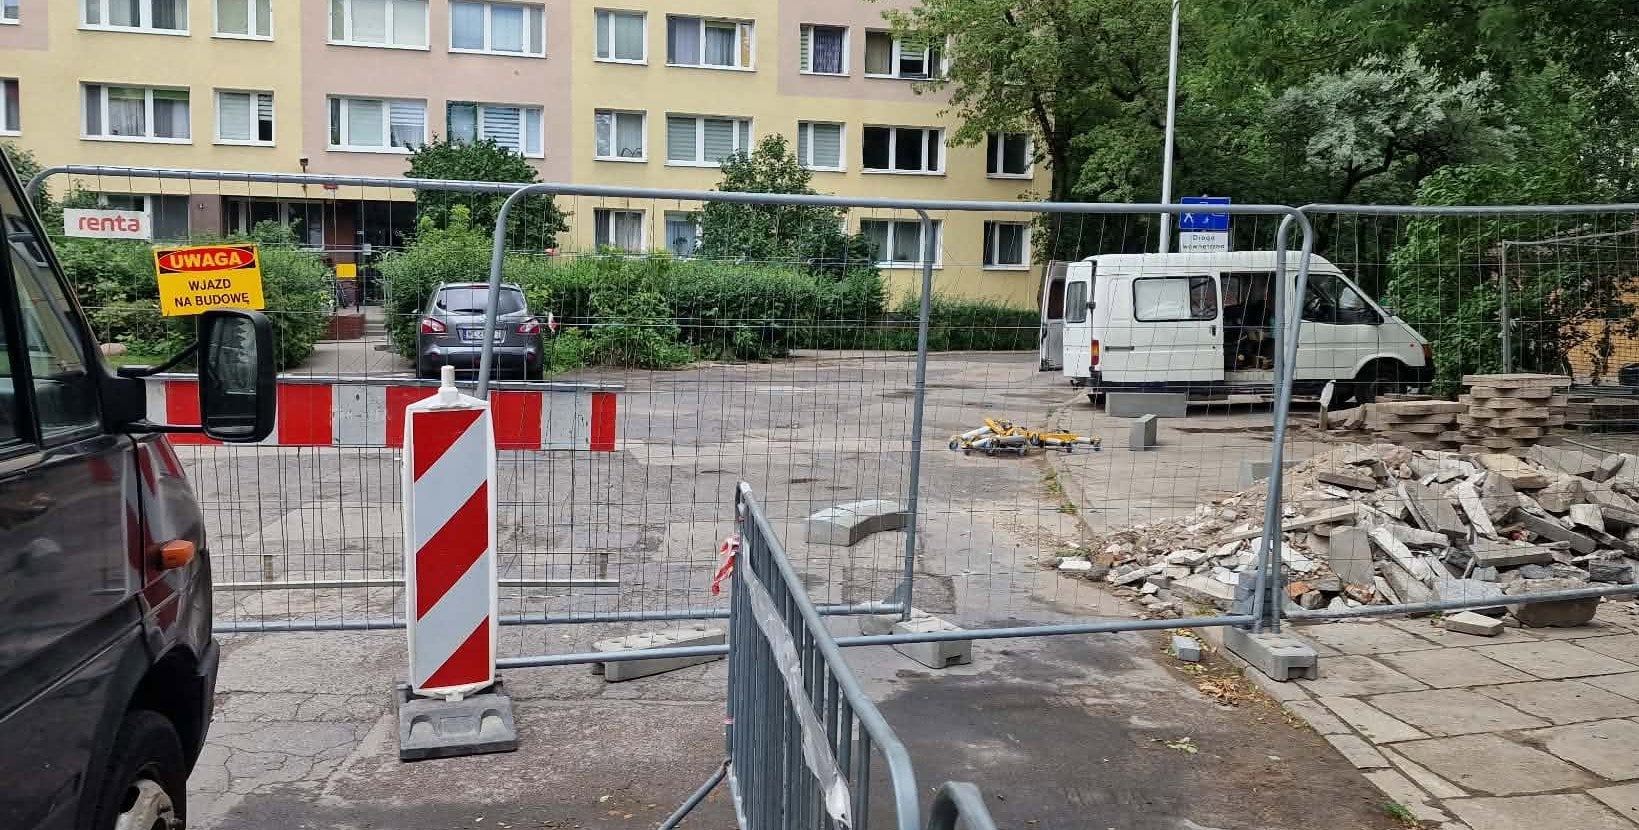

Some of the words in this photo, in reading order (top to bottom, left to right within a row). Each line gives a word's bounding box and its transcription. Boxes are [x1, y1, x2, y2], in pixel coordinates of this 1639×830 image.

[79, 215, 140, 232] renta
[170, 252, 243, 269] UWAGA
[189, 278, 231, 291] WJAZD
[175, 297, 192, 308] NA
[195, 292, 250, 306] BUDOWĘ
